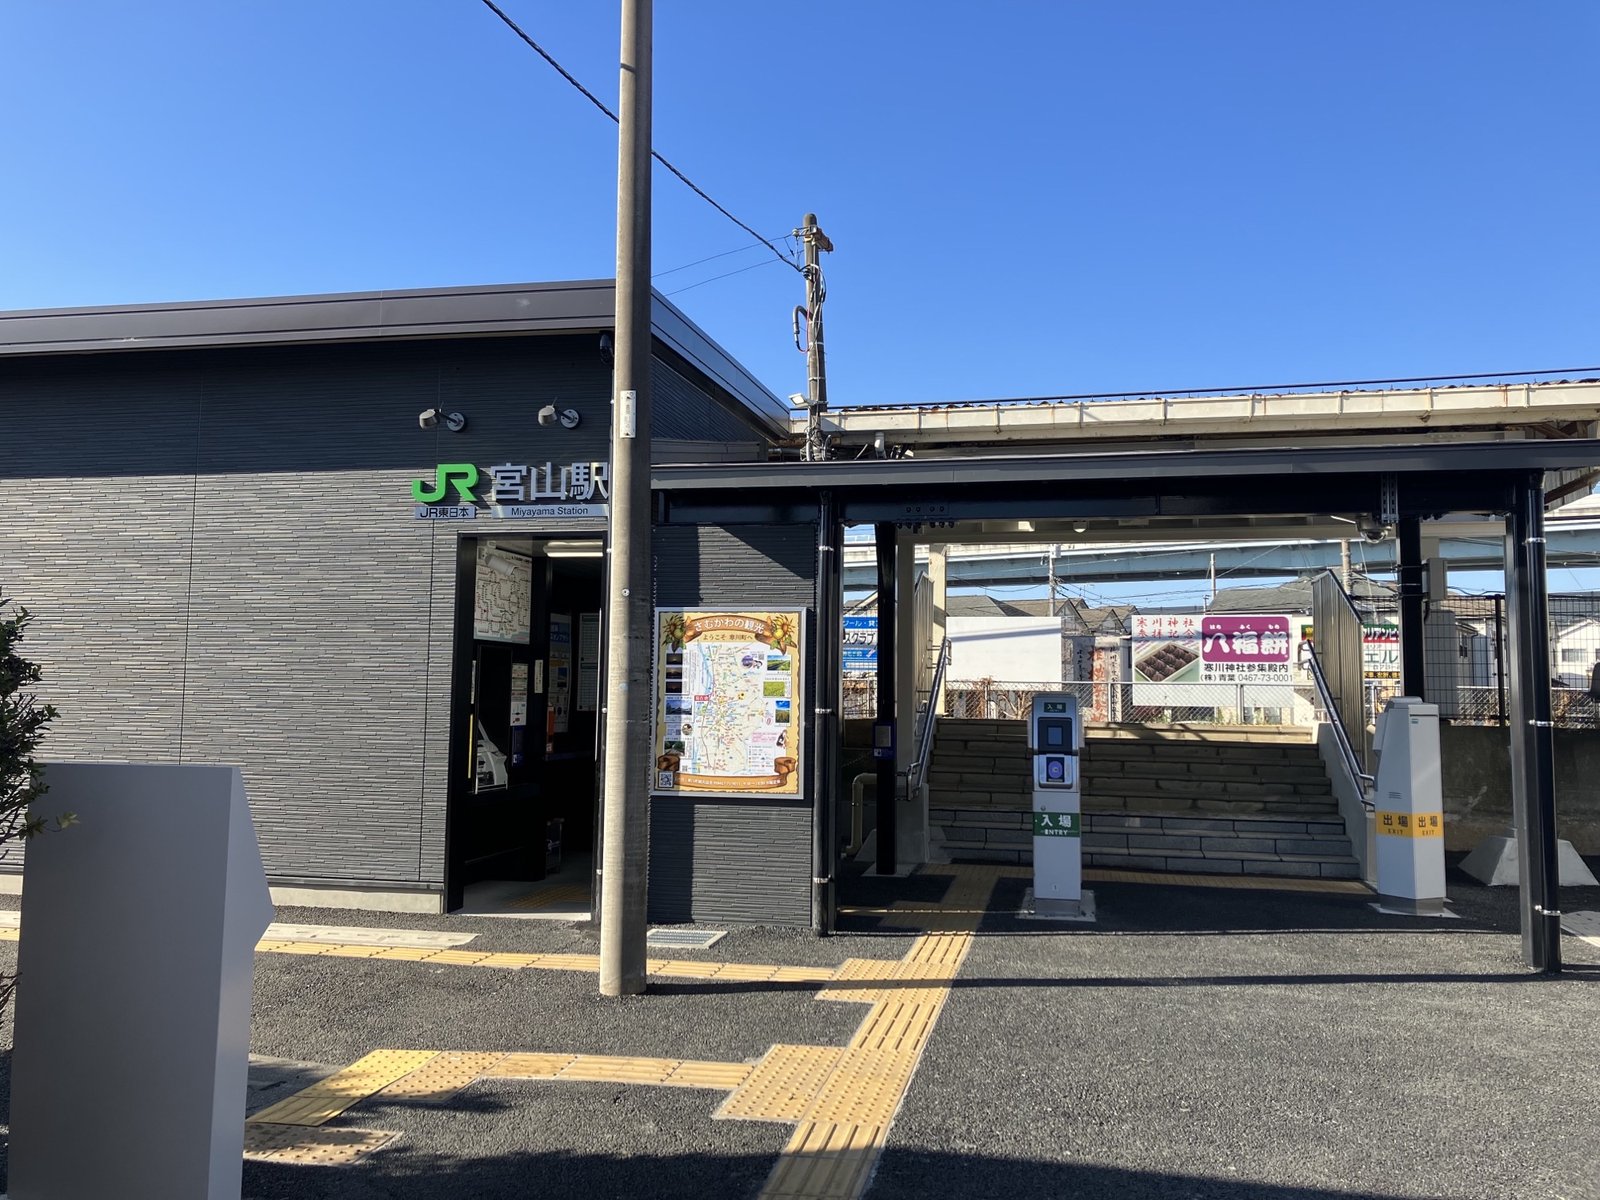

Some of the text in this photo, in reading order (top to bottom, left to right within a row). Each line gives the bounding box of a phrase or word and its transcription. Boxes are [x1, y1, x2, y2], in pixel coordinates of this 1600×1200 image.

[411, 463, 479, 503] JR
[490, 462, 608, 501] 宮山駅
[420, 507, 470, 518] JR東日本
[511, 506, 589, 517] Miyayama Station
[694, 617, 765, 634] さむかわの観光
[1137, 617, 1195, 628] 寒川神社
[1203, 631, 1288, 655] 八福餅
[1204, 663, 1289, 673] 寒川神社参集殿内
[1238, 674, 1293, 682] 0467-73-0001
[1041, 814, 1072, 828] 入場
[1383, 814, 1408, 828] 出場
[1418, 815, 1438, 828] 出場
